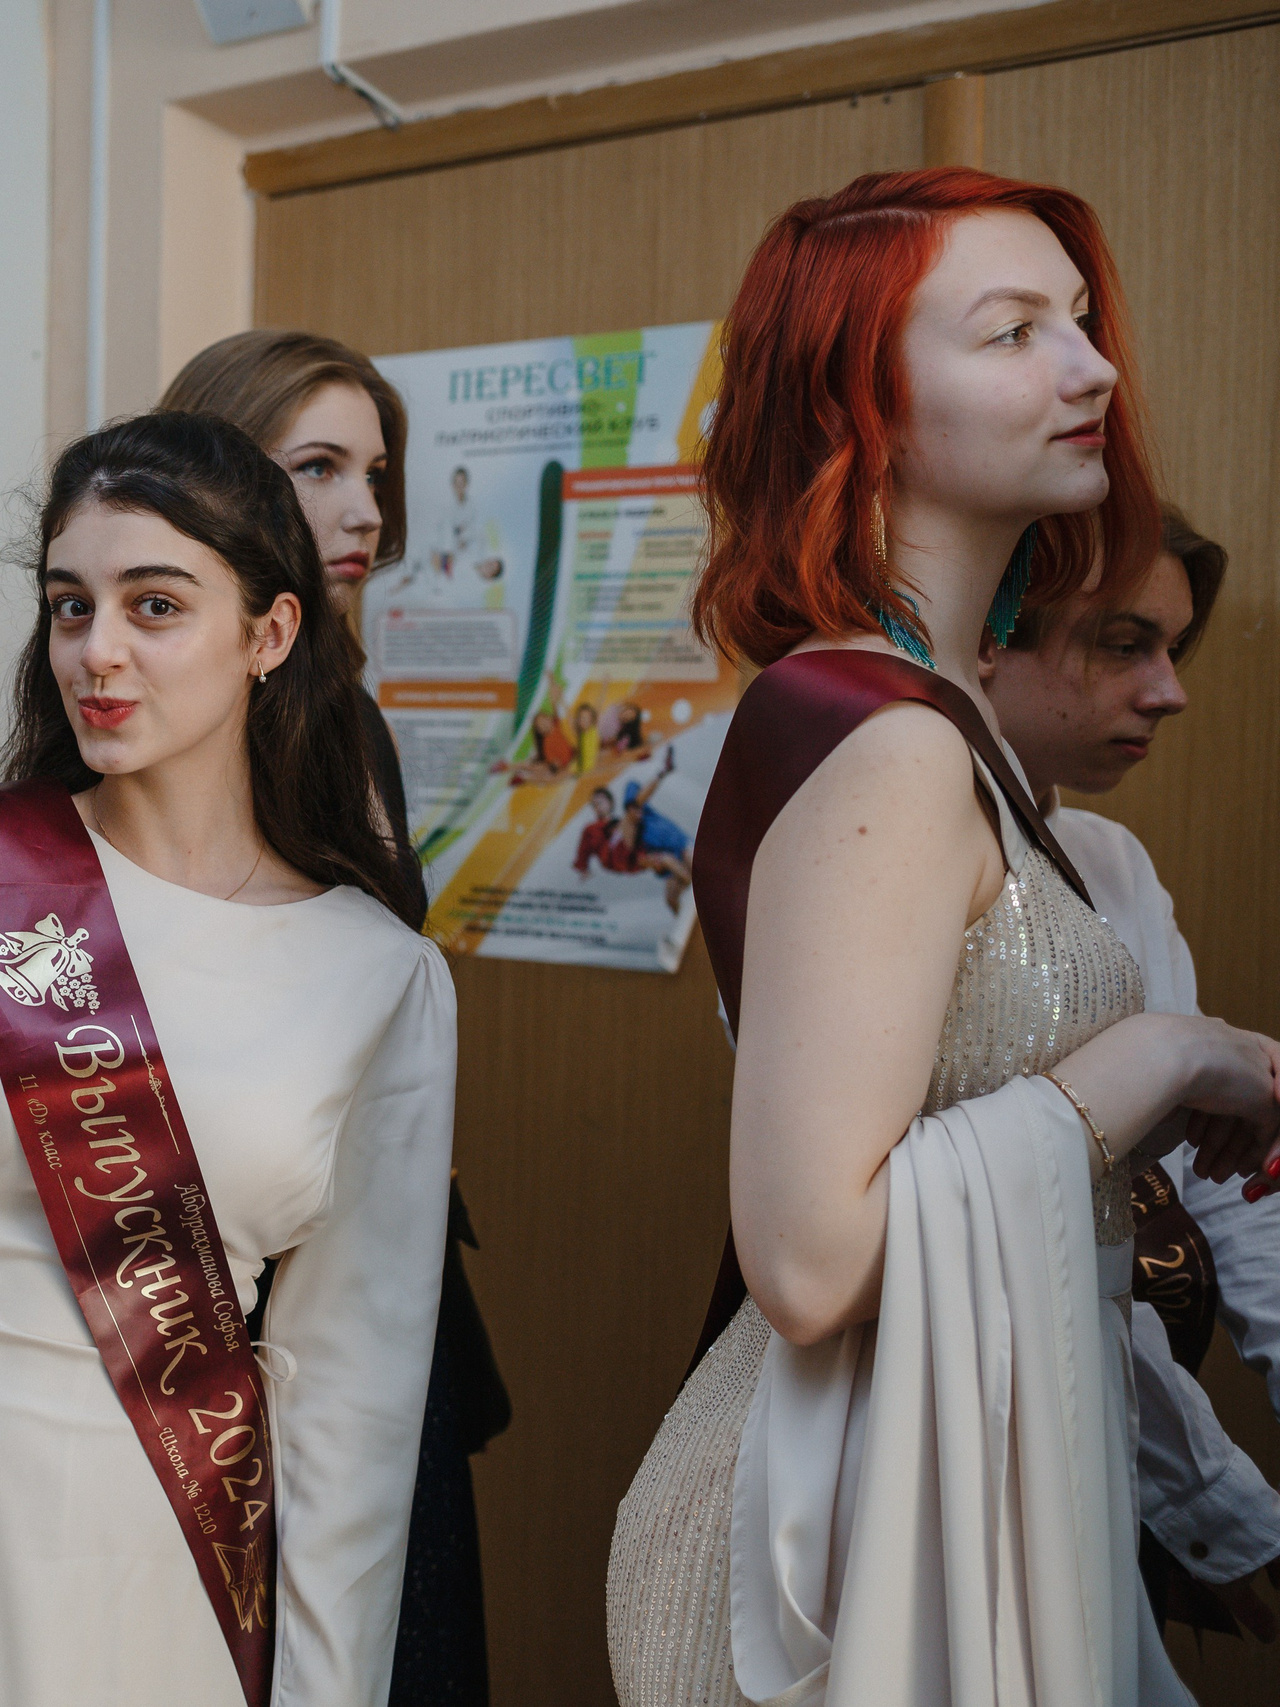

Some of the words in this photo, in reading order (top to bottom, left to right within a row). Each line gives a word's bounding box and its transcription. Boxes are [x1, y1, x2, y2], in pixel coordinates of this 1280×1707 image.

[449, 350, 656, 402] ПЕРЕСВЕТ
[18, 1074, 39, 1093] 11
[38, 1130, 63, 1171] класс
[54, 1024, 208, 1396] Выпускник
[187, 1391, 269, 1532] 2024
[174, 1183, 226, 1299] Абдурахманова
[213, 1301, 241, 1353] Софья
[158, 1427, 190, 1480] Школа
[182, 1480, 203, 1500] №
[193, 1501, 217, 1535] 1210
